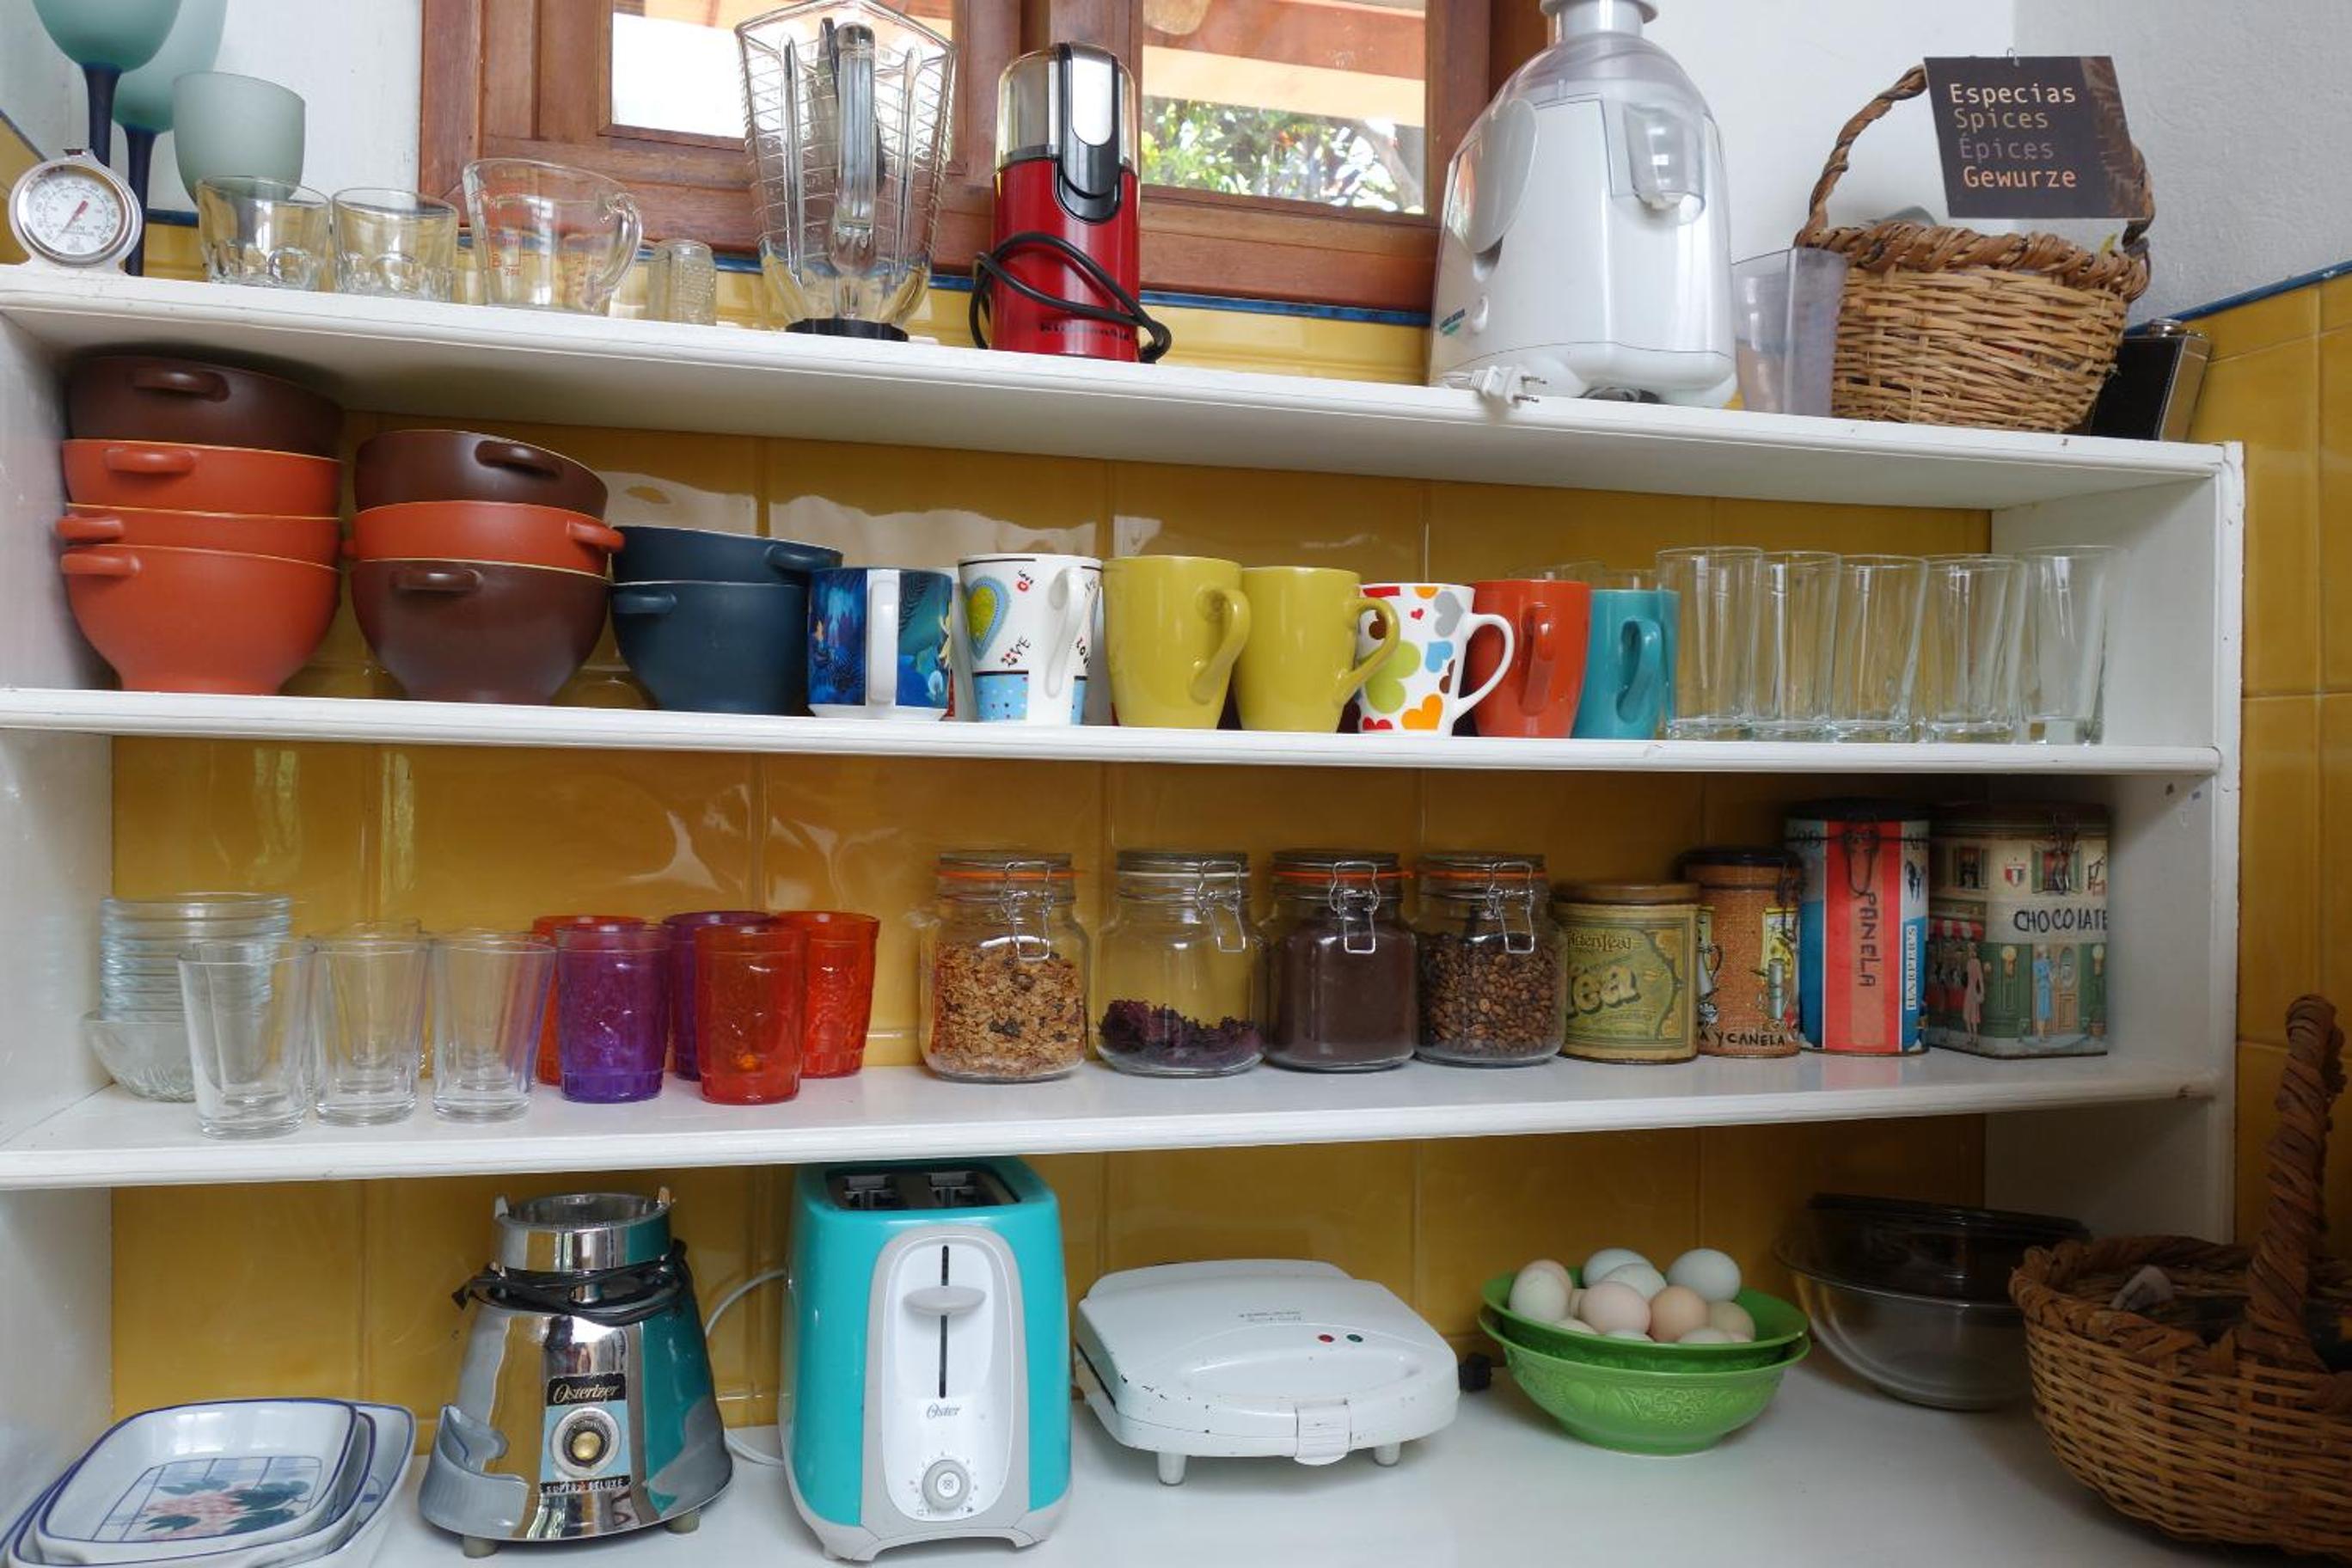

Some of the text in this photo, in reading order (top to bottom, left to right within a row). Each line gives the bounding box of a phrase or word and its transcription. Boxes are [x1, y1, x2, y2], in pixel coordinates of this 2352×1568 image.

[1949, 83, 2077, 107] Especias
[1954, 107, 2049, 132] Spices
[1959, 133, 2055, 162] Épices
[1963, 165, 2078, 187] Gewurze
[1857, 892, 1882, 987] PANELA
[1726, 1032, 1785, 1046] CANELA
[926, 1402, 961, 1420] Oster
